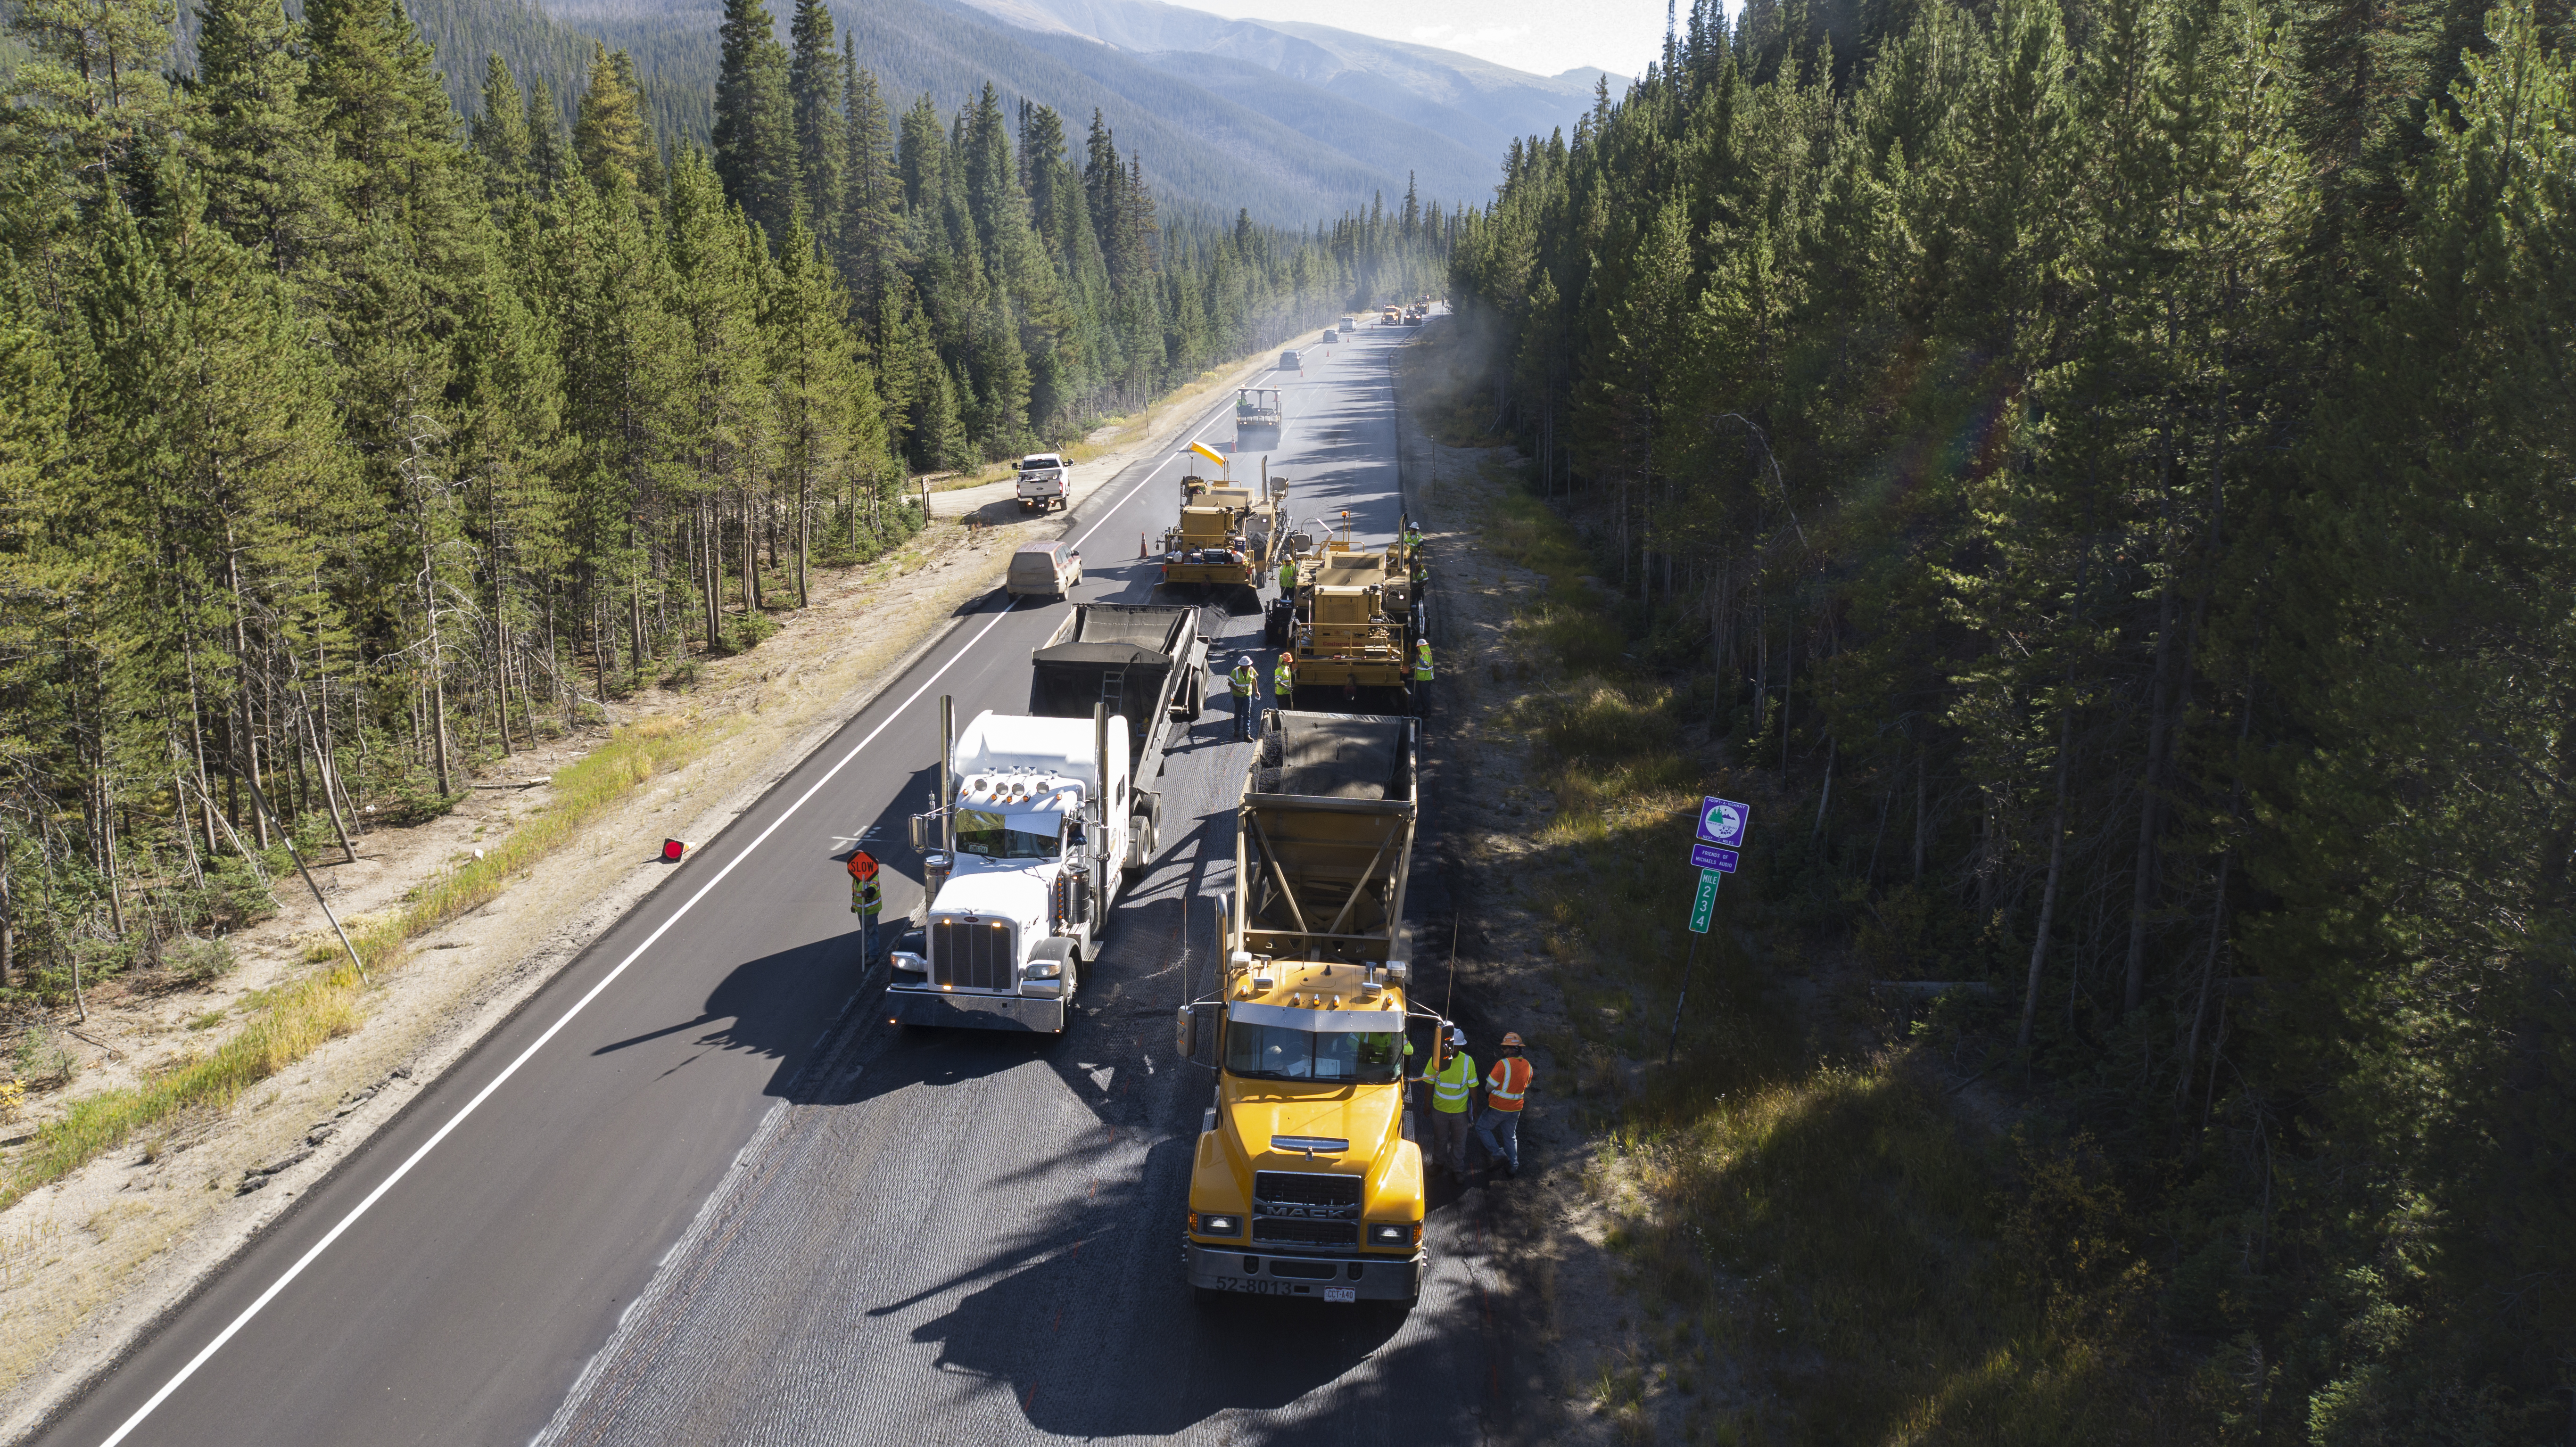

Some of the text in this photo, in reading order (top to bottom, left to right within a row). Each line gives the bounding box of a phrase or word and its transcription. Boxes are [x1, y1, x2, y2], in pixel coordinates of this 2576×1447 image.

[1695, 856, 1716, 864] MICHAELS
[851, 862, 874, 872] SLOW
[1702, 874, 1717, 884] MILE
[1266, 1207, 1346, 1219] MACK
[1216, 1276, 1292, 1296] 52-8013
